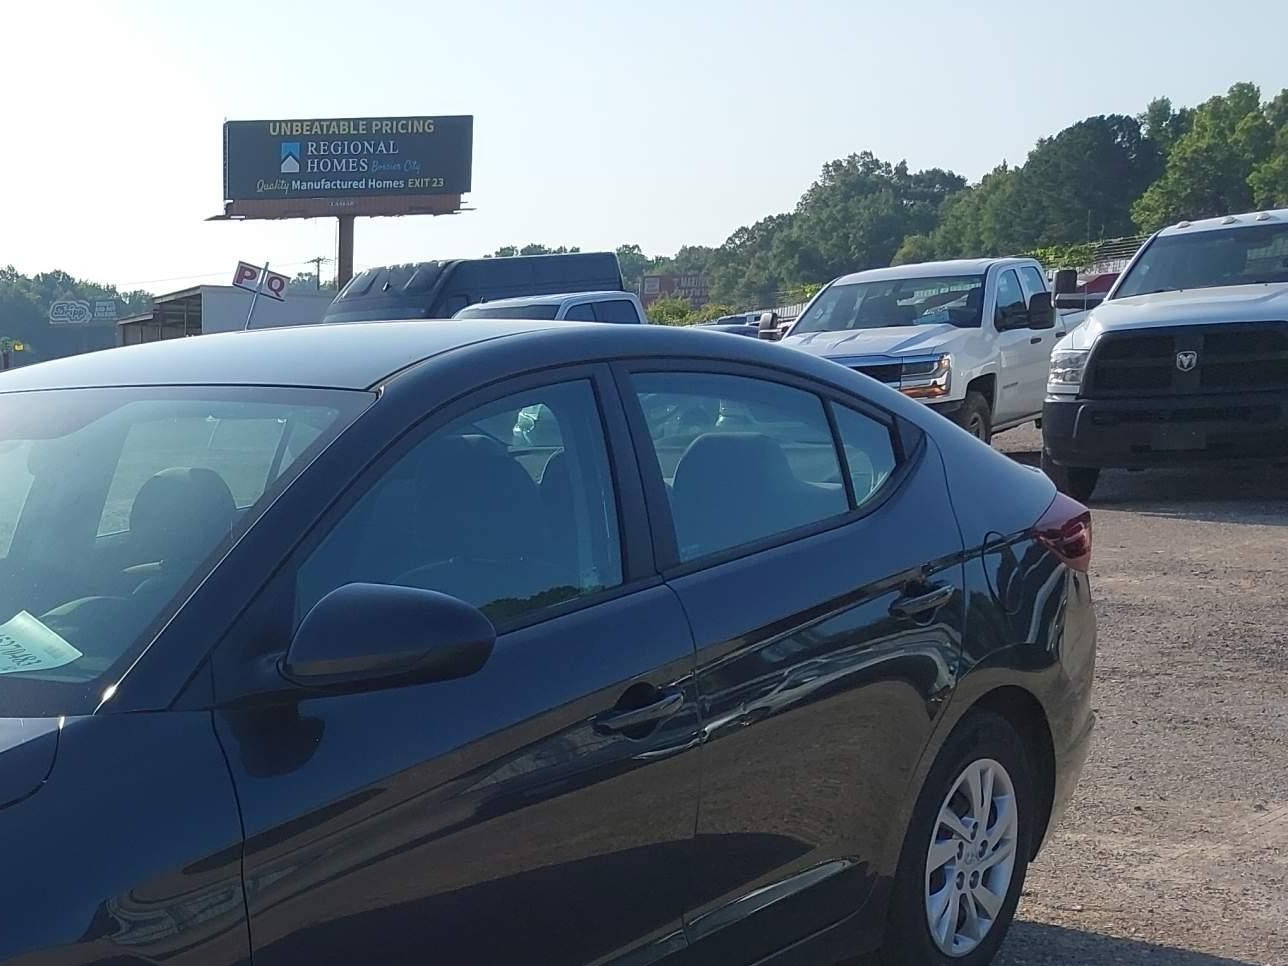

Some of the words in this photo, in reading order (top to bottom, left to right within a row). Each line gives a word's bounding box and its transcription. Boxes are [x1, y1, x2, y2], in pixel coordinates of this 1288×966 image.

[269, 121, 367, 136] UNBEATABLE
[372, 119, 434, 134] PRICING
[307, 140, 399, 155] REGIONAL
[307, 158, 368, 172] HOMES
[256, 179, 290, 195] Quality
[291, 179, 366, 191] Manufactured
[368, 178, 405, 189] Homes
[407, 178, 430, 188] EXIT
[431, 178, 444, 187] 23
[236, 265, 257, 284] P
[267, 276, 285, 297] Q
